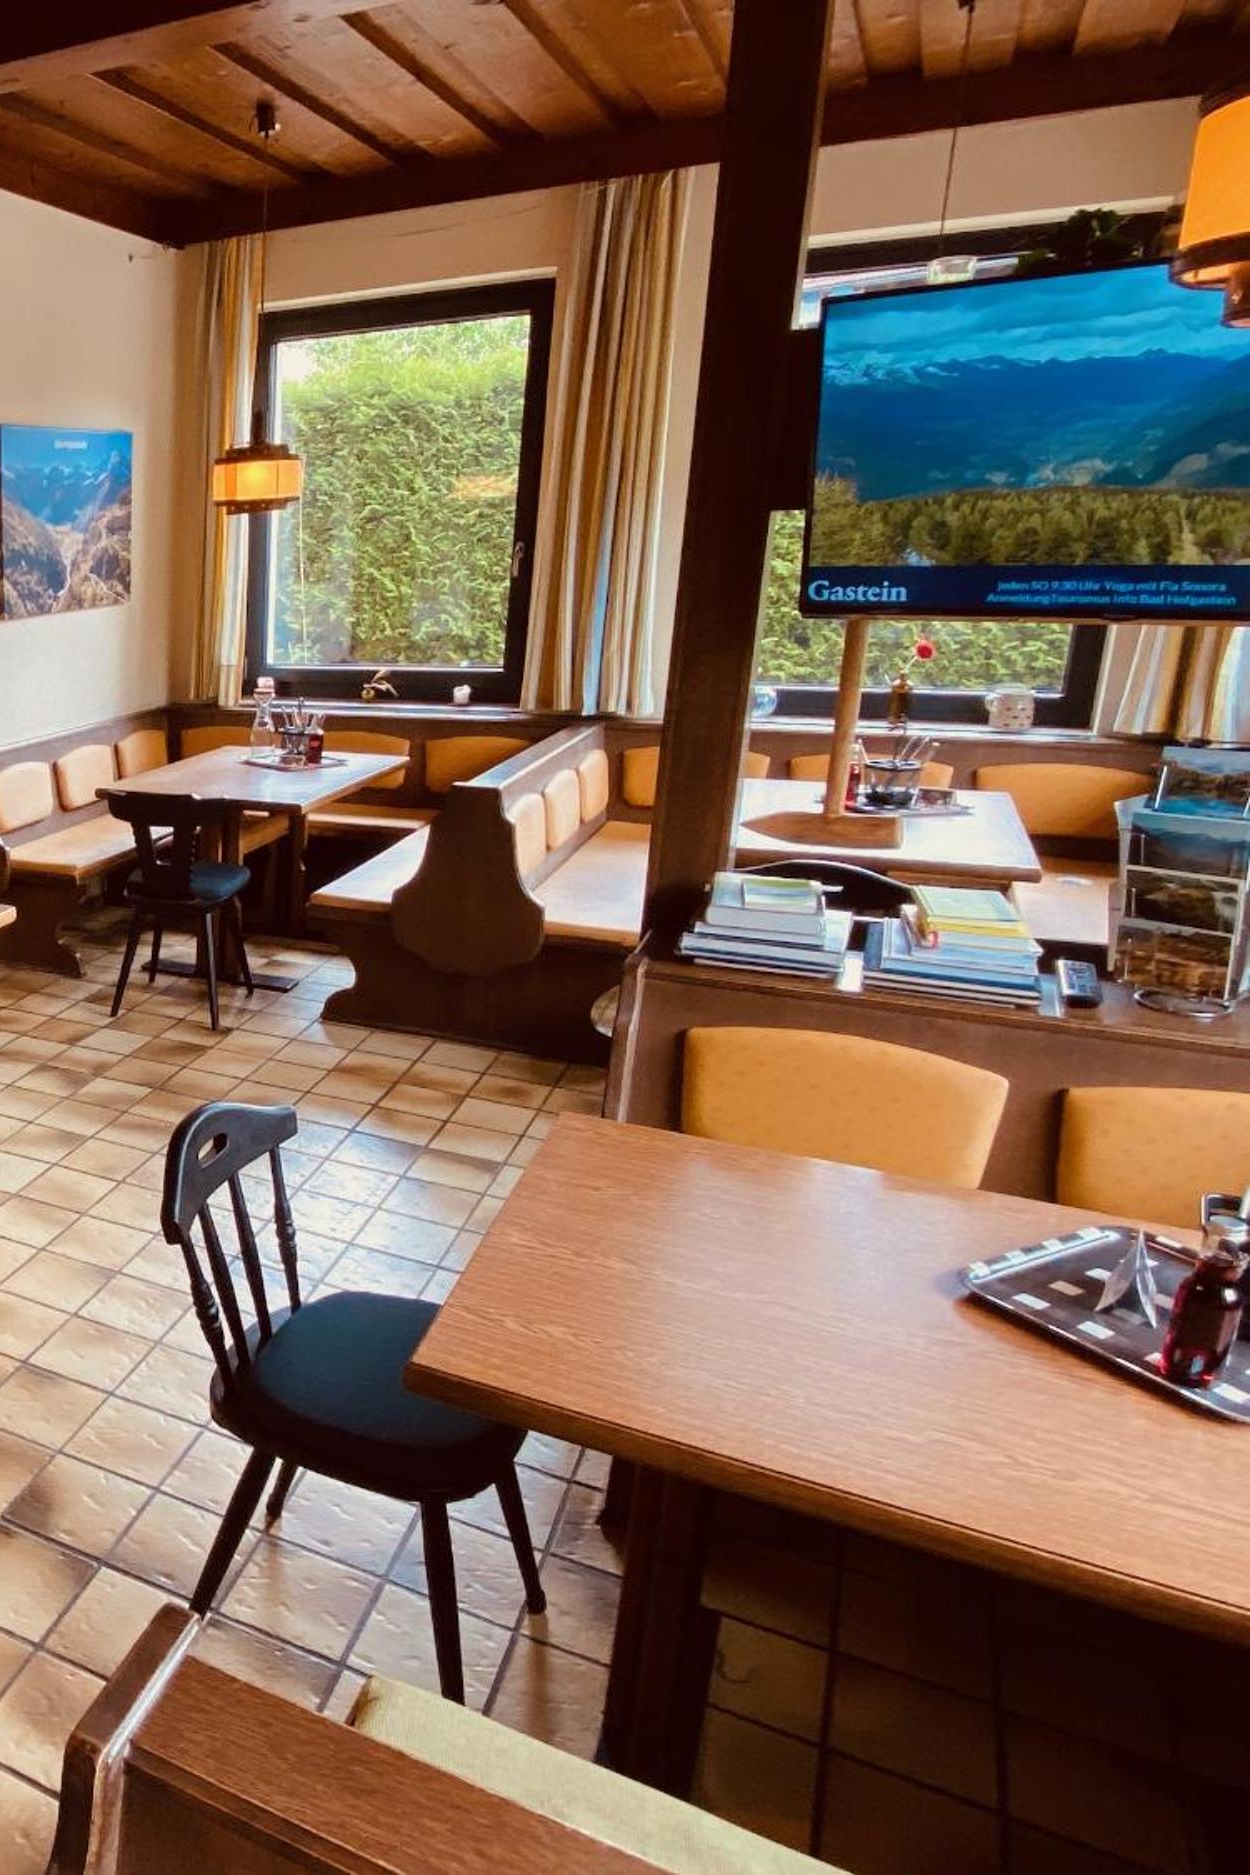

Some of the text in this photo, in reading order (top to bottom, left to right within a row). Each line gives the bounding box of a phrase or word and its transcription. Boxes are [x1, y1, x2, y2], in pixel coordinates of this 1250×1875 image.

[808, 580, 908, 602] Gastein
[1030, 581, 1049, 591] SO
[1079, 581, 1101, 591] Uhr
[1103, 581, 1135, 593] Yoga
[1136, 581, 1156, 592] mit
[985, 593, 1050, 605] Anmeldung
